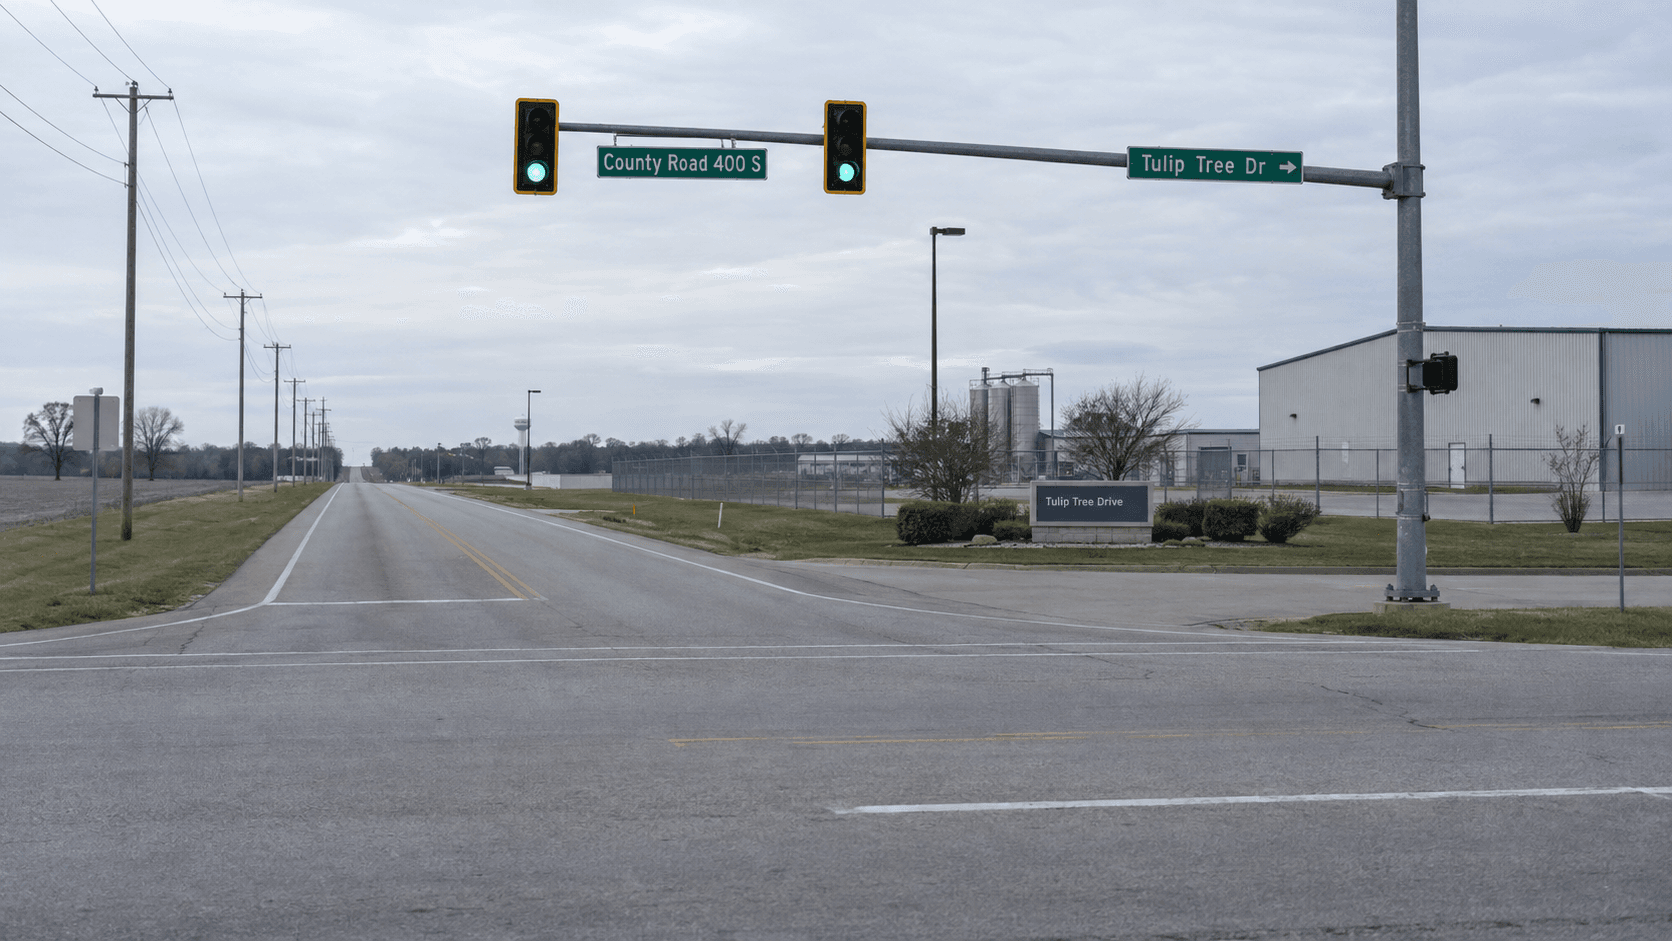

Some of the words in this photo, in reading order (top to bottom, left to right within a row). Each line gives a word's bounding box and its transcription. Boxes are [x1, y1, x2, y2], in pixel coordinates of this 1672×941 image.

[603, 153, 662, 176] County
[668, 154, 708, 172] Road
[713, 155, 746, 172] 400
[751, 155, 762, 173] S
[1141, 154, 1185, 177] Tulip
[1196, 155, 1235, 174] Tree
[1245, 157, 1266, 175] Dr
[1046, 496, 1070, 508] Tulip
[1073, 497, 1094, 506] Tree
[1098, 497, 1124, 506] Drive
